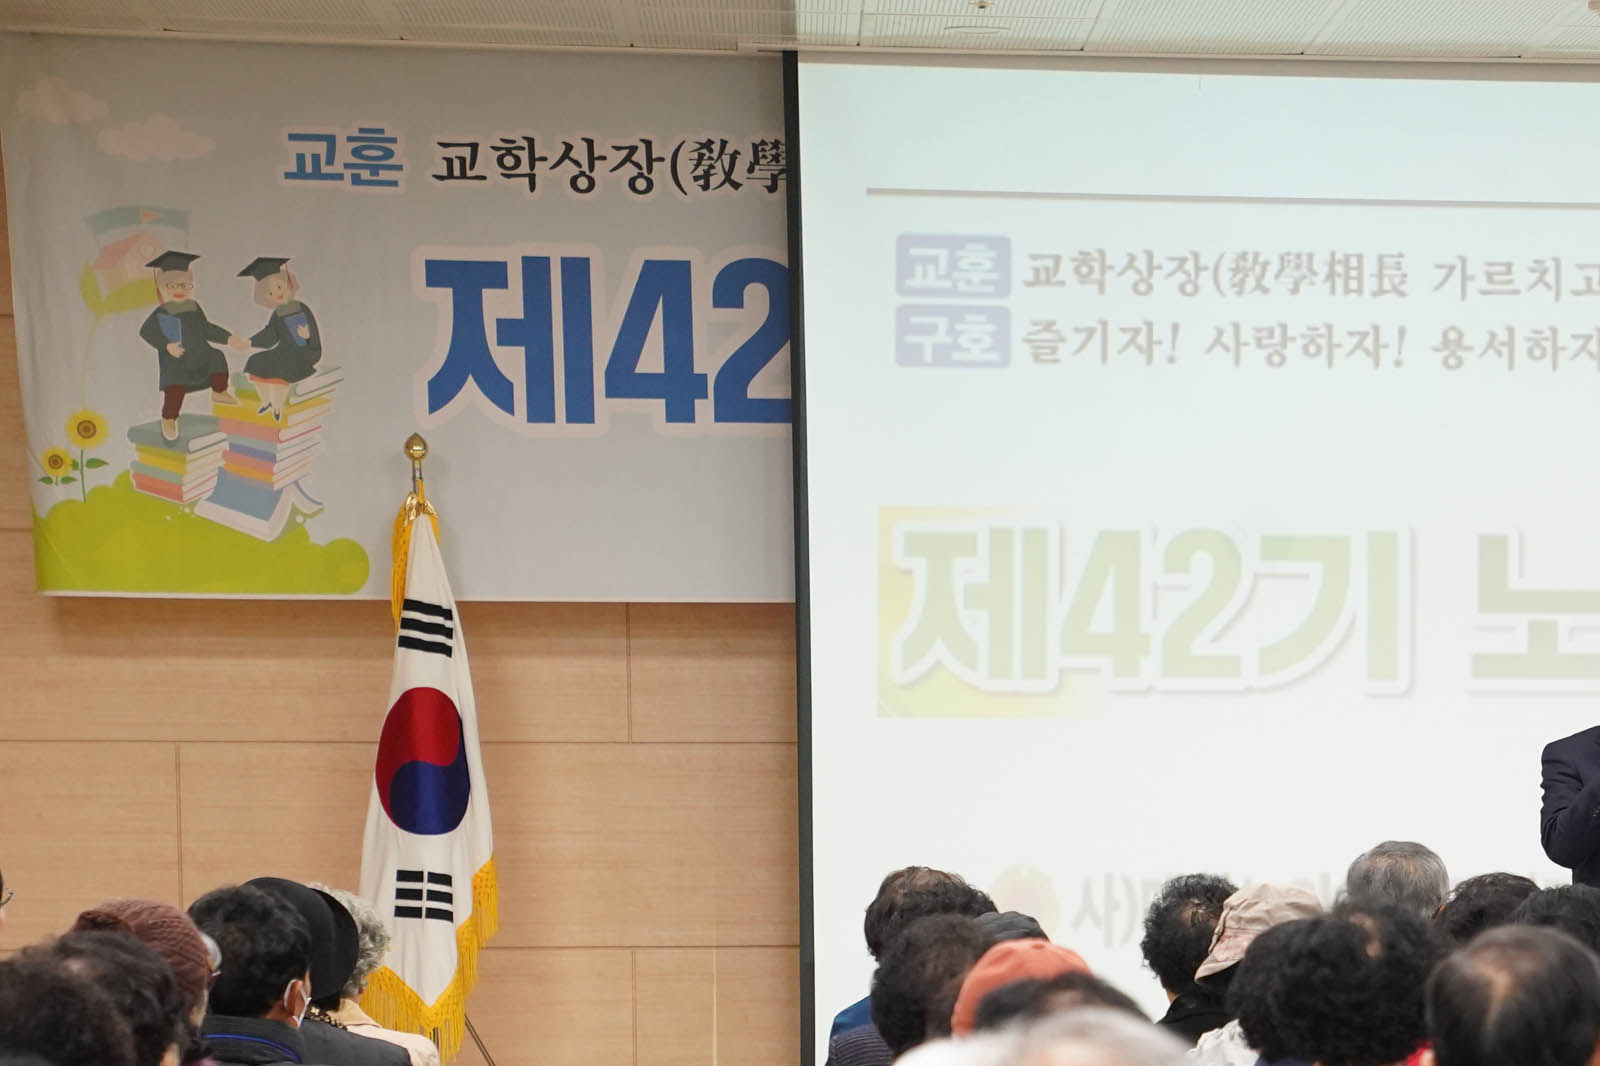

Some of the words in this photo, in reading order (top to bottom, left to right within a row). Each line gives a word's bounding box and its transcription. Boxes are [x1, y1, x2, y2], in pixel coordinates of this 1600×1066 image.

[284, 128, 404, 188] 교훈
[904, 243, 1000, 294] 교훈
[424, 255, 793, 425] 제42
[904, 309, 1000, 364] 구호
[1022, 319, 1182, 367] 즐기자!
[1205, 321, 1410, 370] 사랑하자!
[902, 526, 1402, 684] 제42기
